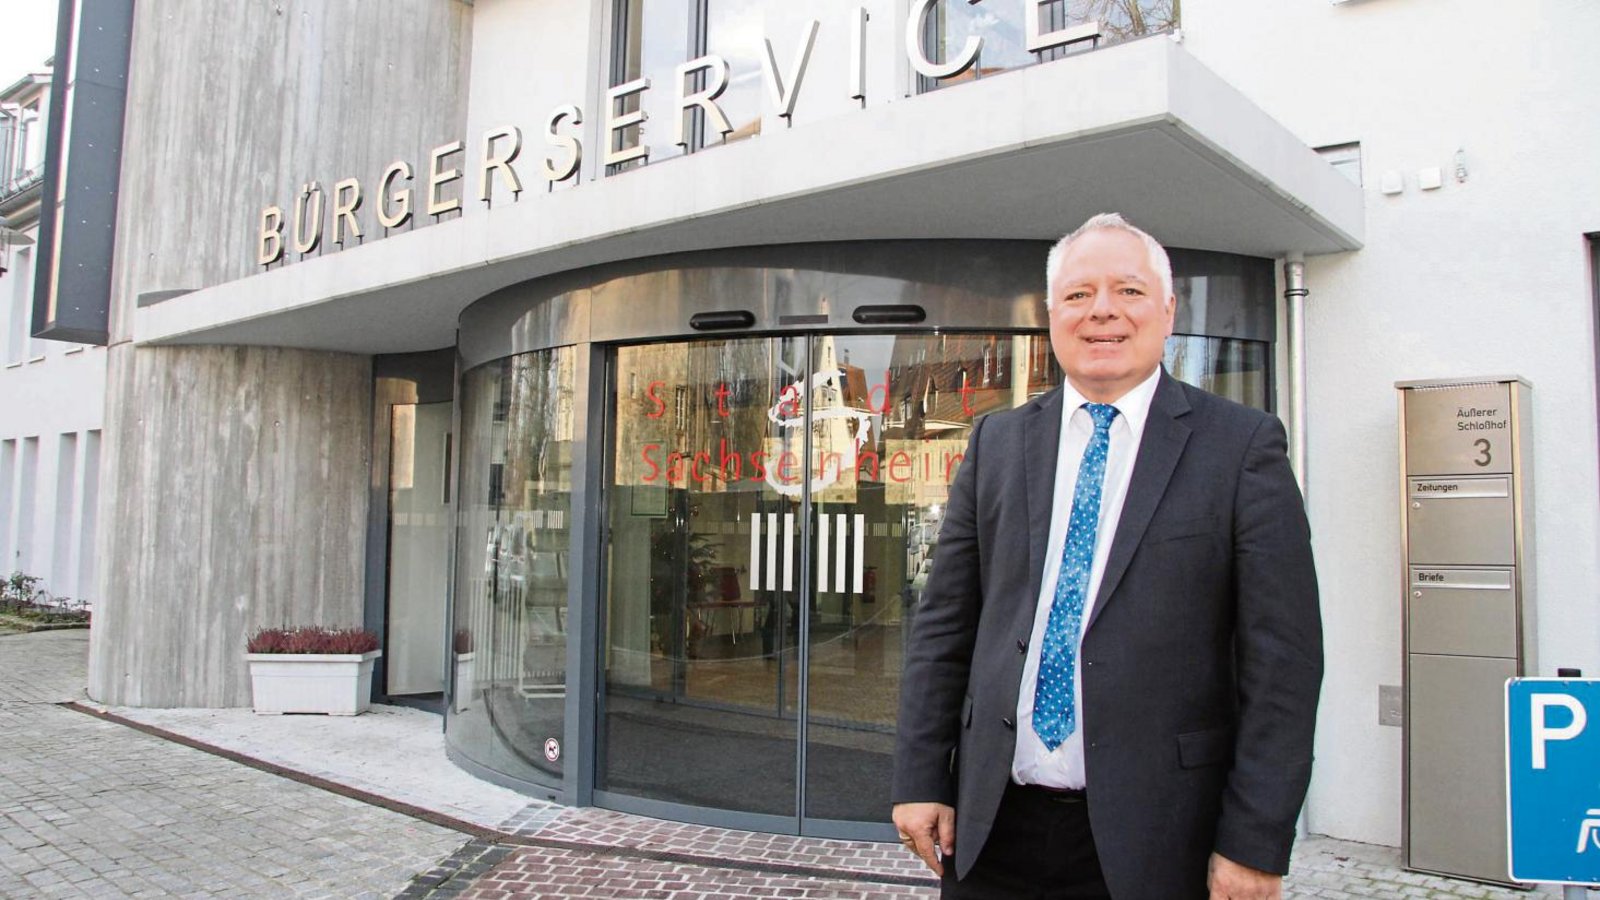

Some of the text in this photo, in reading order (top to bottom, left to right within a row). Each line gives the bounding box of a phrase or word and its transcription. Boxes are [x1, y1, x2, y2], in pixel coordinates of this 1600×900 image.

[1456, 407, 1498, 418] Äußerer
[1457, 420, 1507, 431] Schloßhof
[1473, 438, 1492, 467] 3
[1417, 483, 1458, 493] Zeitungen
[1418, 573, 1444, 582] Briefe
[1530, 693, 1588, 770] P
